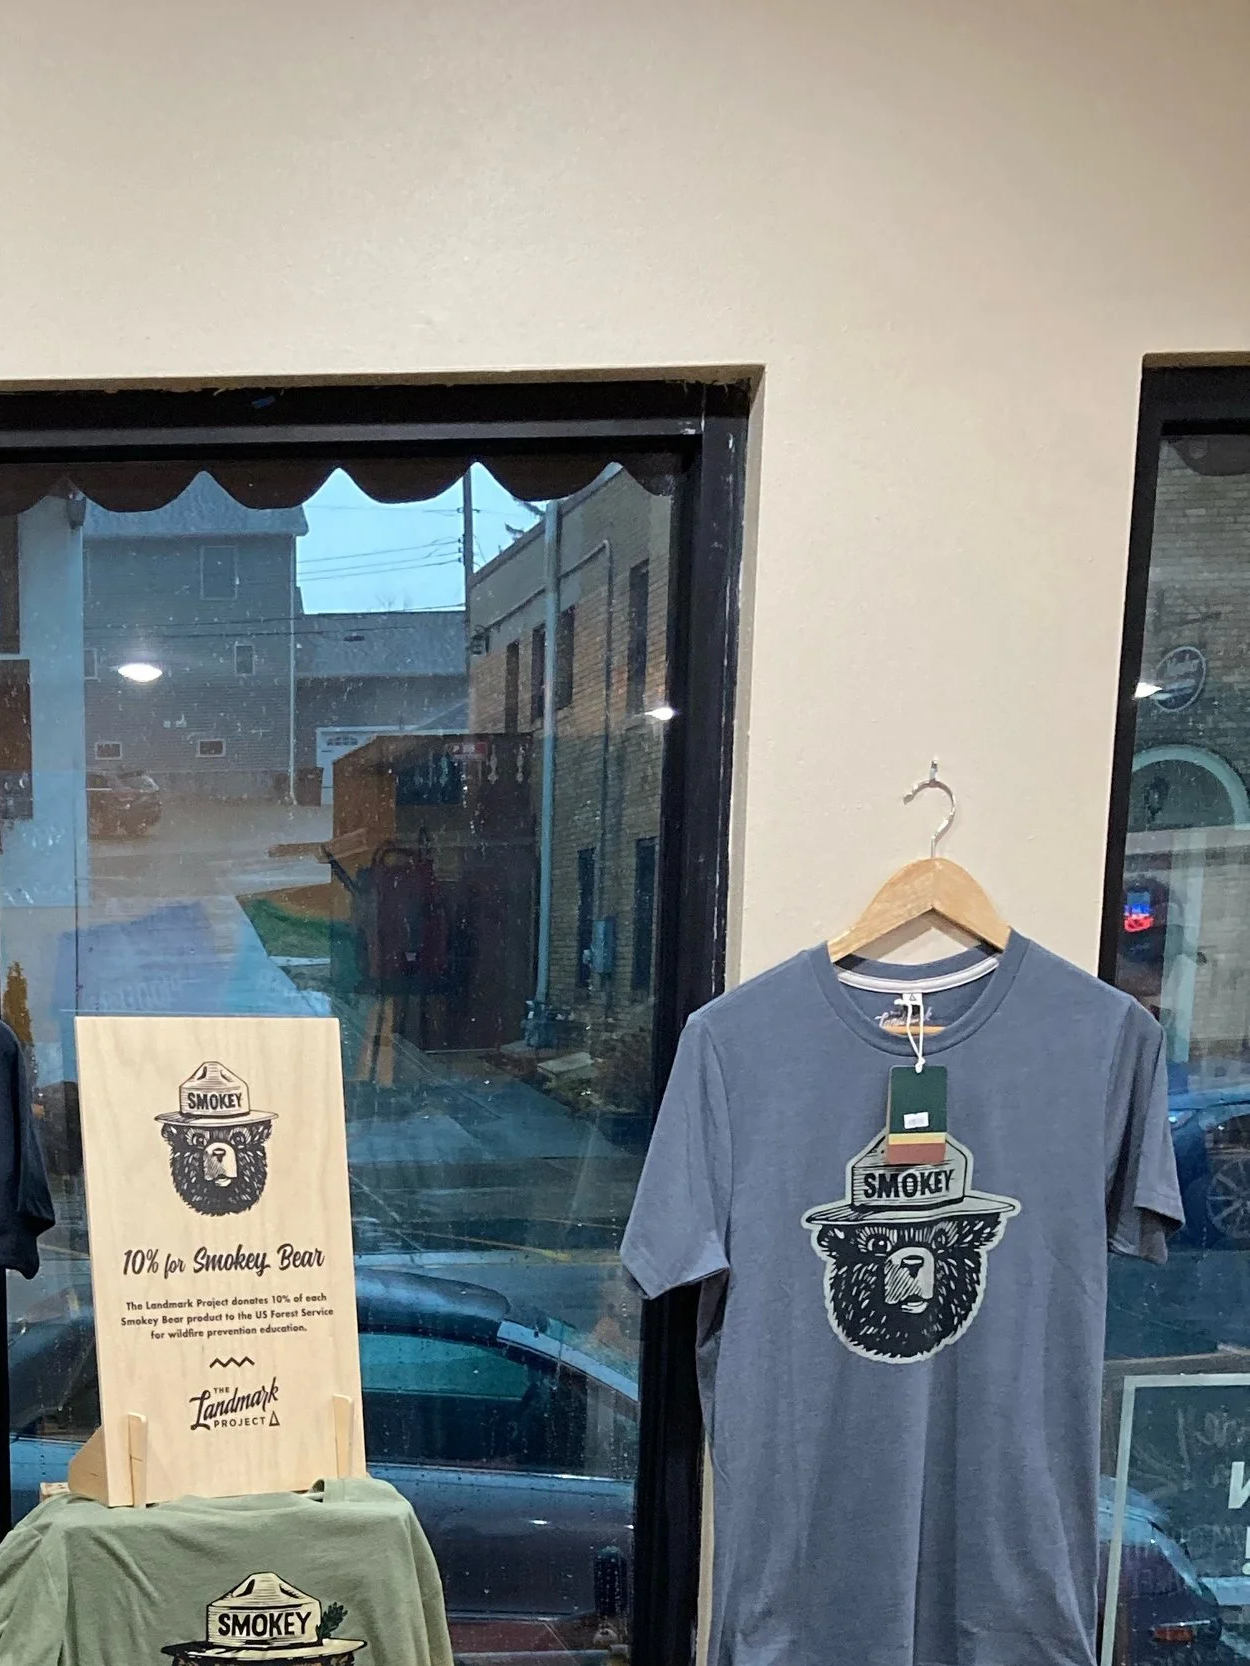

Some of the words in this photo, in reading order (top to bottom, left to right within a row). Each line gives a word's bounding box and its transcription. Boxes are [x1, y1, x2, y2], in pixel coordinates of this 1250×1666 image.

[187, 1091, 243, 1110] SMOKEY
[862, 1168, 954, 1199] SMOKEY
[123, 1249, 159, 1275] 10%
[164, 1253, 186, 1279] for
[193, 1244, 271, 1277] Smokey
[277, 1243, 325, 1271] Bear
[126, 1302, 143, 1311] The
[146, 1299, 193, 1310] Landmark
[196, 1298, 229, 1309] Project
[231, 1296, 268, 1306] donates
[271, 1294, 291, 1304] 10%
[293, 1293, 304, 1303] of
[305, 1292, 327, 1303] each
[121, 1315, 159, 1327] Smokey
[162, 1315, 183, 1325] Bear
[187, 1313, 223, 1325] product
[225, 1312, 235, 1321] to
[238, 1311, 252, 1320] the
[255, 1310, 268, 1319] US
[271, 1309, 299, 1319] Forest
[301, 1307, 334, 1317] Service
[151, 1330, 165, 1340] for
[168, 1328, 204, 1339] wildfire
[207, 1326, 257, 1338] prevention
[259, 1324, 308, 1334] education.
[213, 1386, 230, 1395] THE
[189, 1376, 279, 1431] Landmark
[213, 1416, 265, 1428] PROJECT
[217, 1611, 311, 1638] SMOKEY
